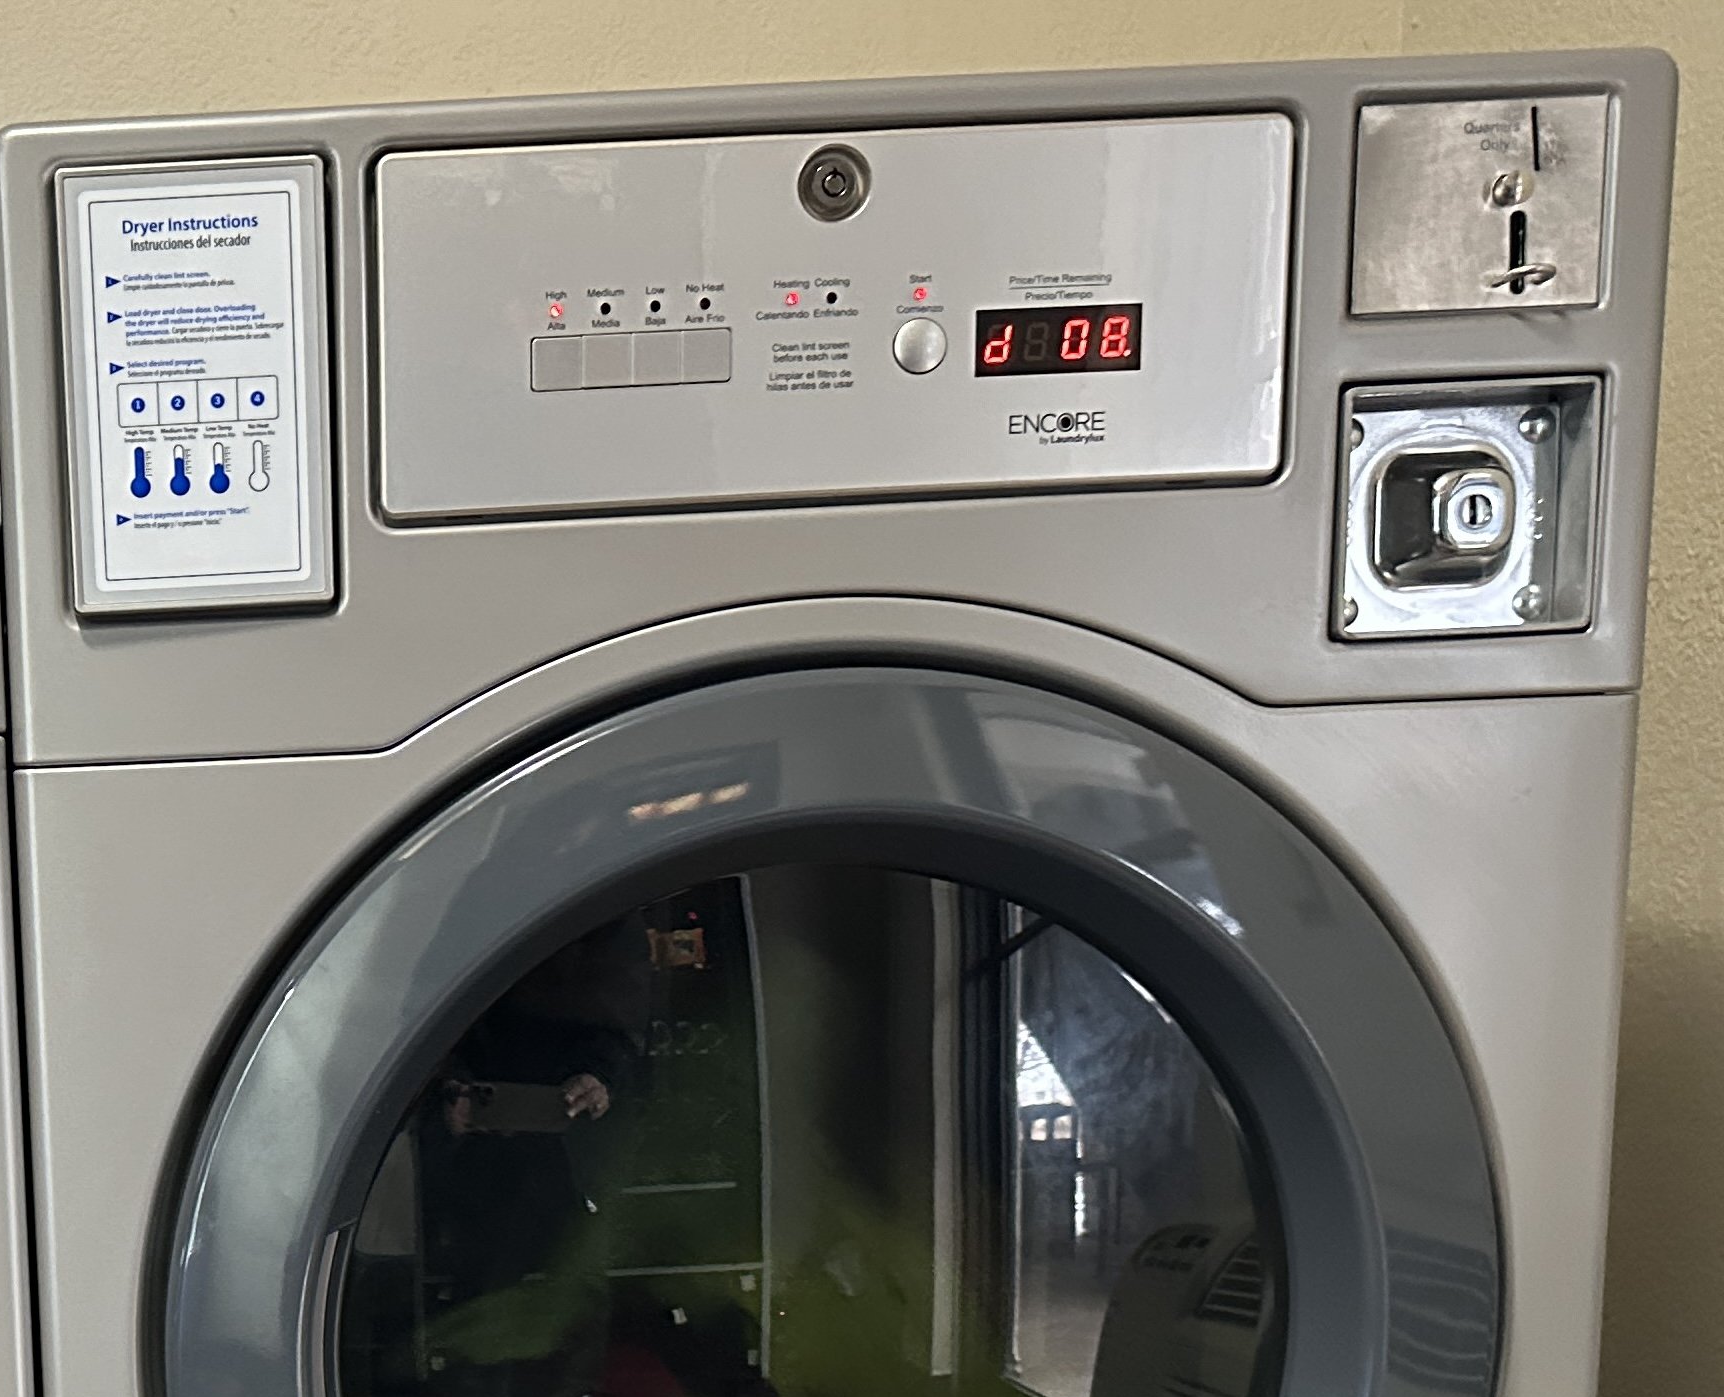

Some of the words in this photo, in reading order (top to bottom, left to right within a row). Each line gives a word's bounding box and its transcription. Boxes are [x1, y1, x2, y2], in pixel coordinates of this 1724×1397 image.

[122, 219, 165, 237] Dryer
[168, 214, 259, 232] Instructions
[130, 238, 194, 252] Instrucciones
[196, 235, 211, 248] del
[214, 233, 251, 247] secador
[123, 273, 153, 282] Carefully
[154, 272, 173, 280] clean
[909, 275, 932, 284] Start
[1009, 275, 1059, 285] Price/Time
[1061, 273, 1112, 283] Remaining
[773, 279, 810, 290] Heating
[814, 277, 851, 288] Cooling
[586, 288, 625, 298] Medium
[645, 286, 665, 295] Low
[685, 284, 700, 293] No
[701, 283, 725, 292] Heat
[545, 291, 567, 301] High
[1025, 290, 1093, 300] Precio/Tiempo
[124, 309, 142, 317] Load
[143, 308, 160, 317] dryer
[214, 304, 256, 312] Overloading
[813, 308, 859, 318] Enfriando
[896, 305, 944, 314] Comienzo
[137, 319, 156, 327] dryer
[195, 316, 218, 324] drying
[218, 314, 251, 322] efficiency
[251, 312, 265, 320] and
[685, 315, 704, 324] Aire
[755, 310, 809, 320] Calentando
[591, 319, 621, 328] Media
[645, 316, 667, 326] Baja
[547, 322, 566, 331] Alta
[772, 343, 799, 352] Clean
[802, 342, 816, 350] lint
[818, 341, 850, 350] screen
[772, 353, 803, 363] before
[805, 352, 829, 362] each
[831, 352, 849, 360] use
[148, 359, 174, 367] desired
[768, 371, 804, 382] Limpiar
[805, 371, 815, 379] el
[816, 369, 838, 379] filtro
[839, 369, 852, 378] de
[790, 381, 816, 391] antes
[818, 381, 831, 390] de
[833, 380, 854, 389] usar
[1008, 411, 1106, 434] ENCORE
[1039, 436, 1050, 445] by
[1050, 434, 1105, 444] Laundrylux
[153, 511, 183, 520] payment
